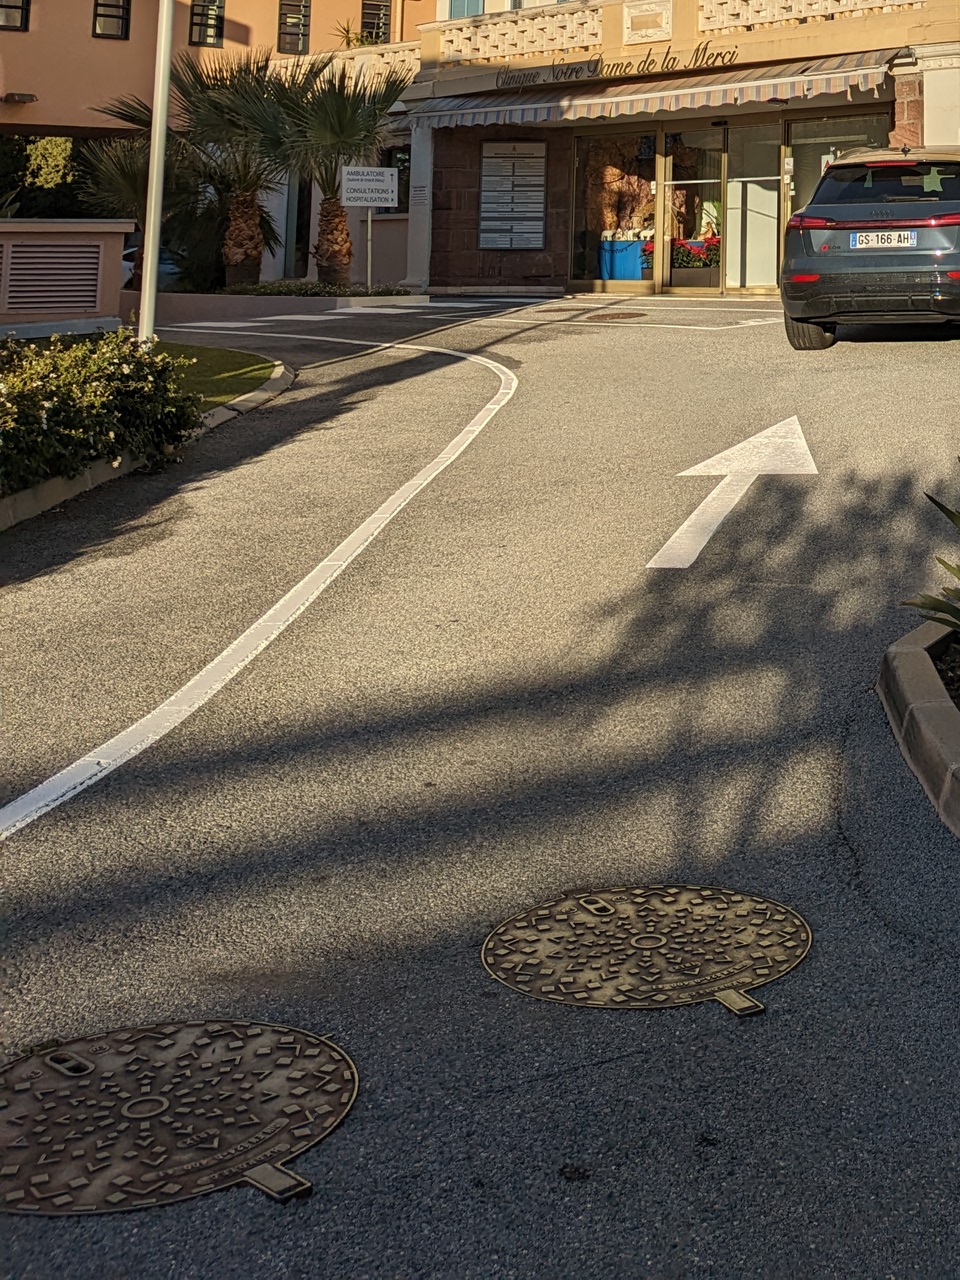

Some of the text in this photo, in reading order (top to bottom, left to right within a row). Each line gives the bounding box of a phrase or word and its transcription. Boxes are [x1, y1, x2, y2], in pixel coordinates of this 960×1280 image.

[495, 40, 739, 93] Clinique Notre Dame de la Merci
[346, 170, 386, 178] AMBULATOIRE
[345, 187, 390, 195] CONSULTATIONS
